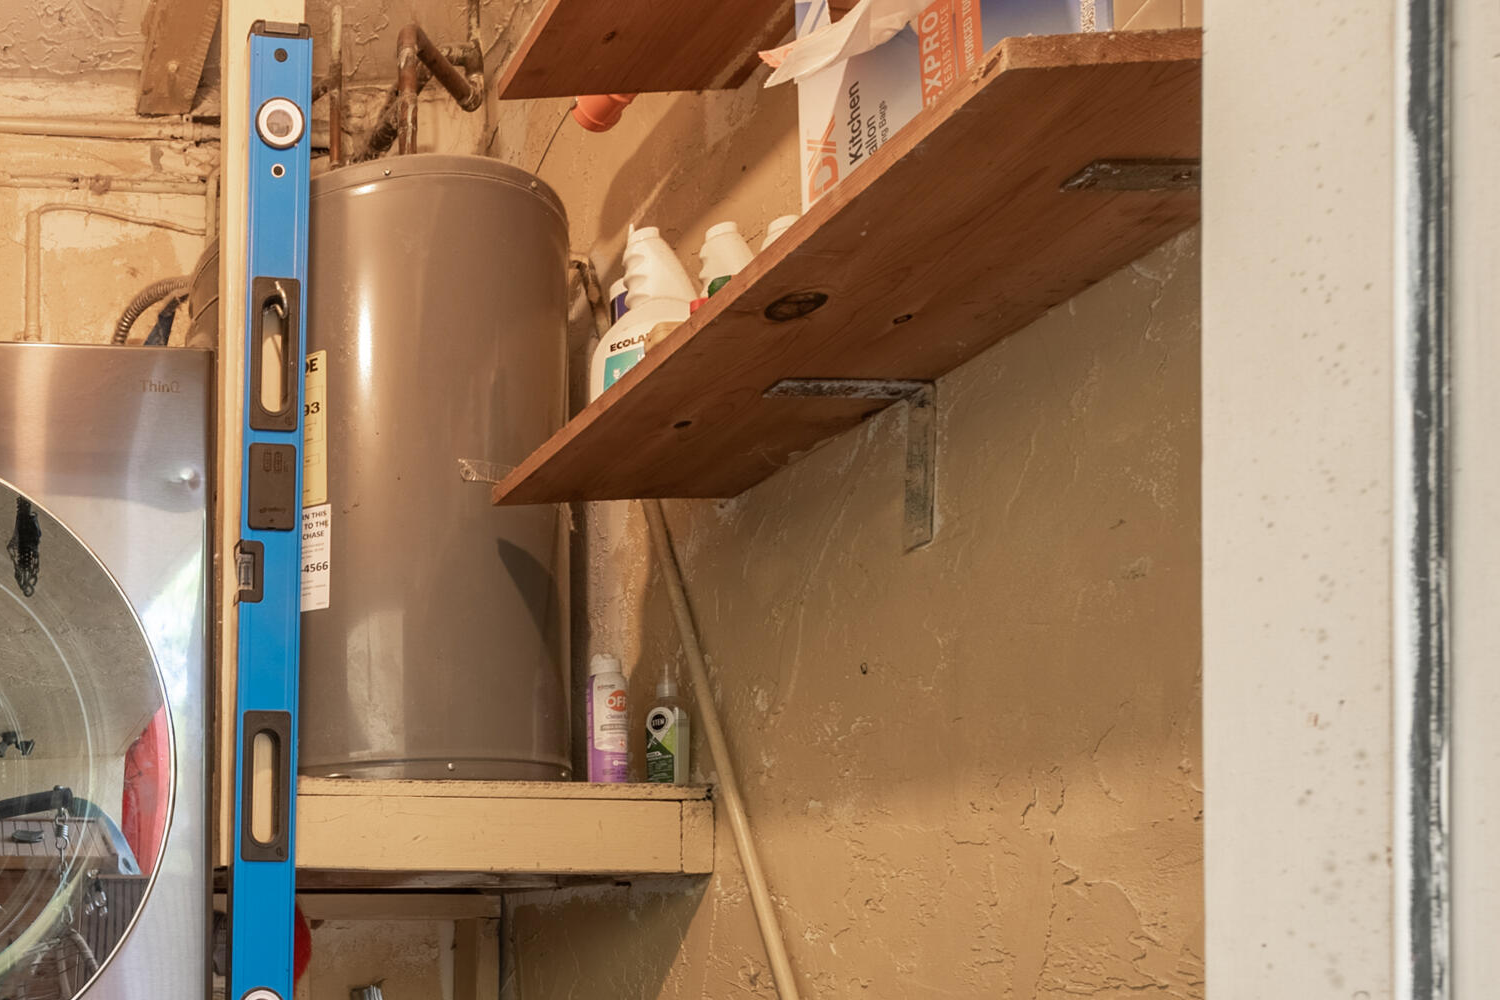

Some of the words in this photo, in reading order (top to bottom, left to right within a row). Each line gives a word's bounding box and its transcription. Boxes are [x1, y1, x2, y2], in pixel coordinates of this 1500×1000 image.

[940, 3, 954, 90] ESISTANCE
[878, 101, 888, 129] Bags
[847, 81, 863, 165] Kitchen
[865, 115, 879, 156] allon
[140, 379, 180, 394] ThinQ
[312, 510, 327, 519] THIS
[304, 522, 314, 530] TO
[303, 530, 324, 541] CHASE
[651, 717, 665, 727] STEM
